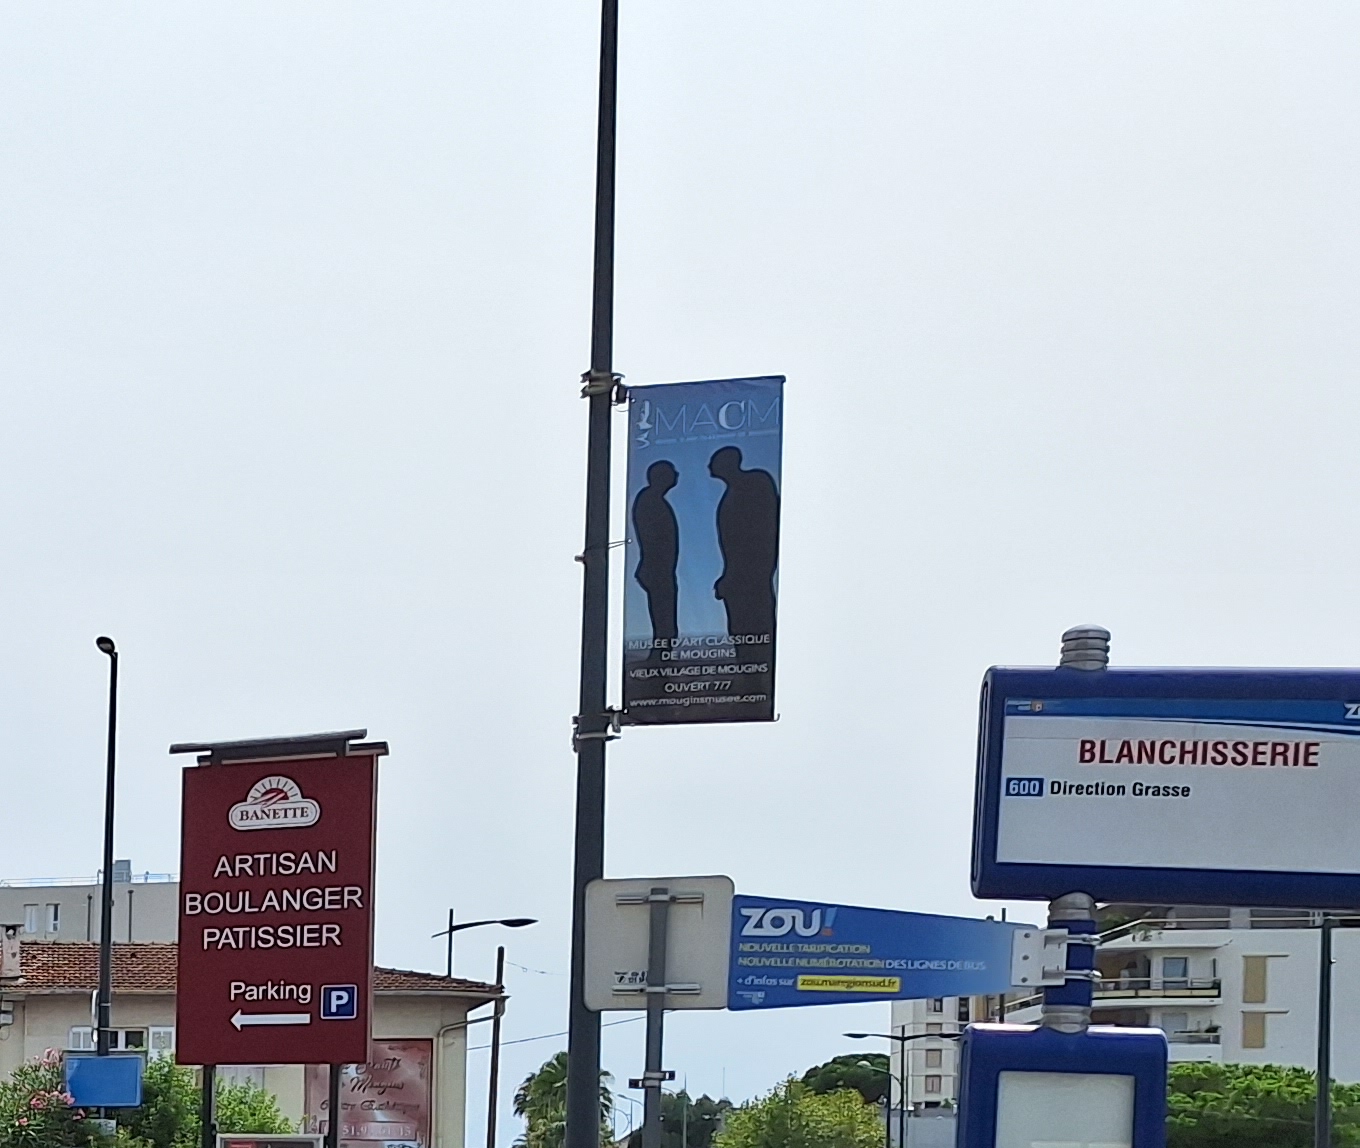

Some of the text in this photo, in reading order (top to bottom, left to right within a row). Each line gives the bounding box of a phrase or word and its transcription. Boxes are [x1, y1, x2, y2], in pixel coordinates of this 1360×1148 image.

[705, 634, 771, 646] CLASSIQUE
[661, 648, 737, 661] DE MOUGINS
[630, 663, 768, 678] VIEUX VILLAGE DE MOUGINS
[664, 681, 709, 693] OUVERT
[1078, 738, 1321, 767] BLANCHISSERIE
[1009, 779, 1191, 797] 600 Direction Grasse
[238, 807, 310, 822] BANETTE
[213, 850, 337, 878] ARTISAN
[184, 886, 364, 915] BOULANGER
[203, 924, 342, 950] PATISSIER
[738, 943, 794, 953] NOUVELLE
[737, 956, 794, 967] NOUVELLE
[885, 959, 907, 969] DES
[907, 960, 947, 970] LIGNES
[229, 981, 349, 1013] Parking P
